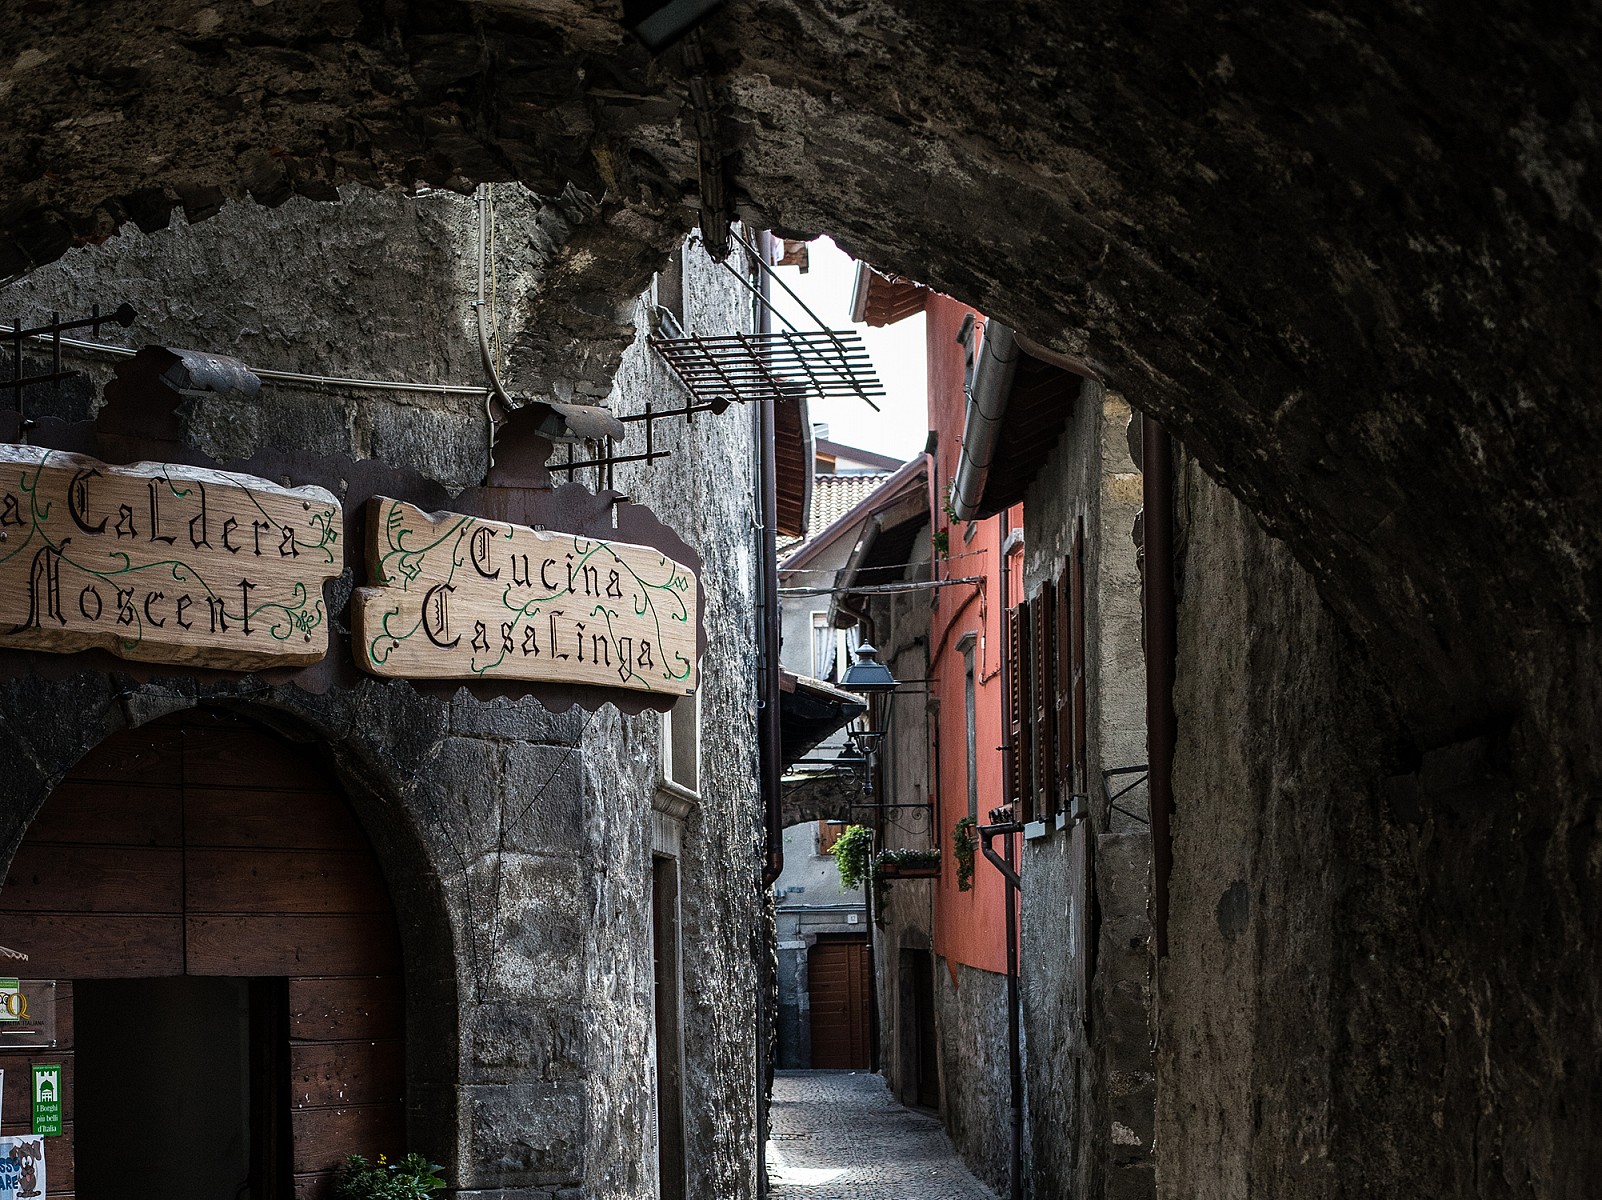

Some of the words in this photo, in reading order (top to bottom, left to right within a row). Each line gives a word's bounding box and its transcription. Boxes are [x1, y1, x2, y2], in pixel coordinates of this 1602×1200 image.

[470, 526, 624, 600] Cucina
[40, 1103, 58, 1113] Borghi
[36, 1114, 45, 1124] più
[46, 1114, 58, 1122] belli
[37, 1125, 57, 1133] d'Italia
